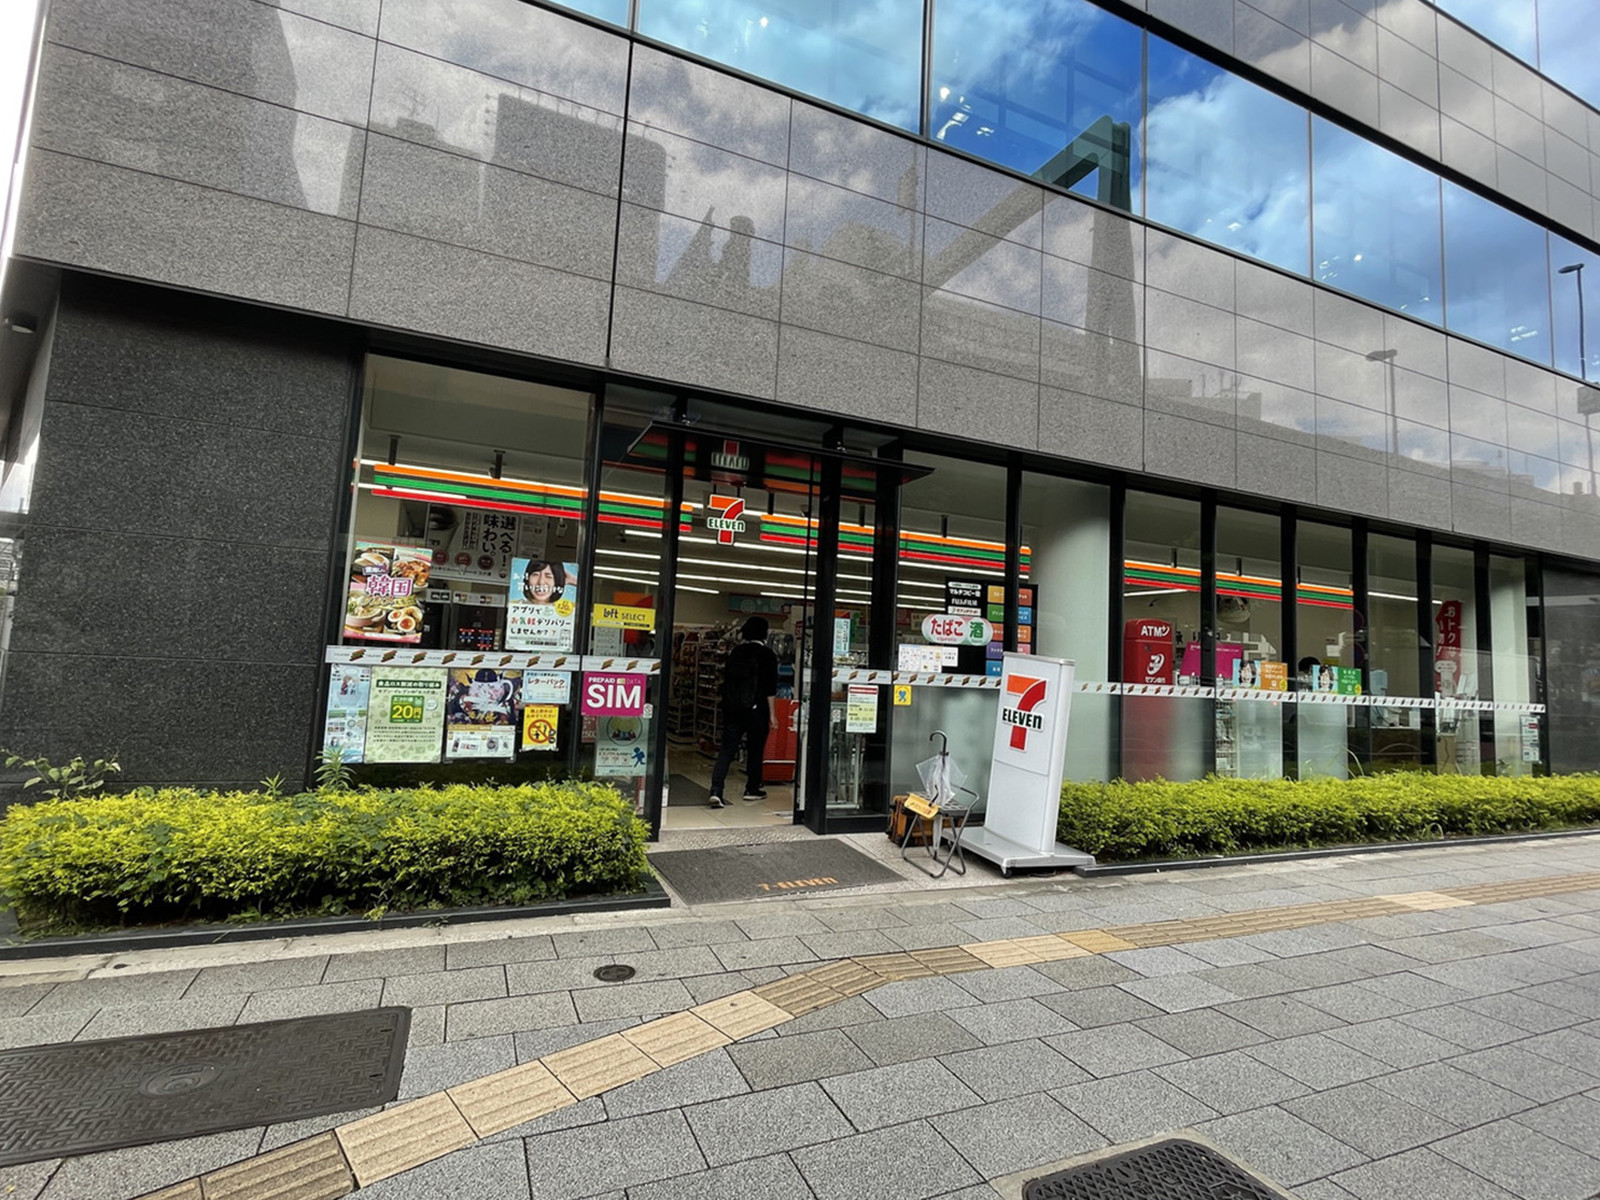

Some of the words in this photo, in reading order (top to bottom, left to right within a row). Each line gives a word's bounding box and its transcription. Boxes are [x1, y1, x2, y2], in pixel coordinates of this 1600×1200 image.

[366, 574, 412, 597] 韓国
[621, 613, 646, 621] SELECT
[931, 618, 964, 637] たばこ
[969, 621, 984, 639] 酒
[1141, 625, 1162, 637] ATM
[586, 683, 641, 709] SIM
